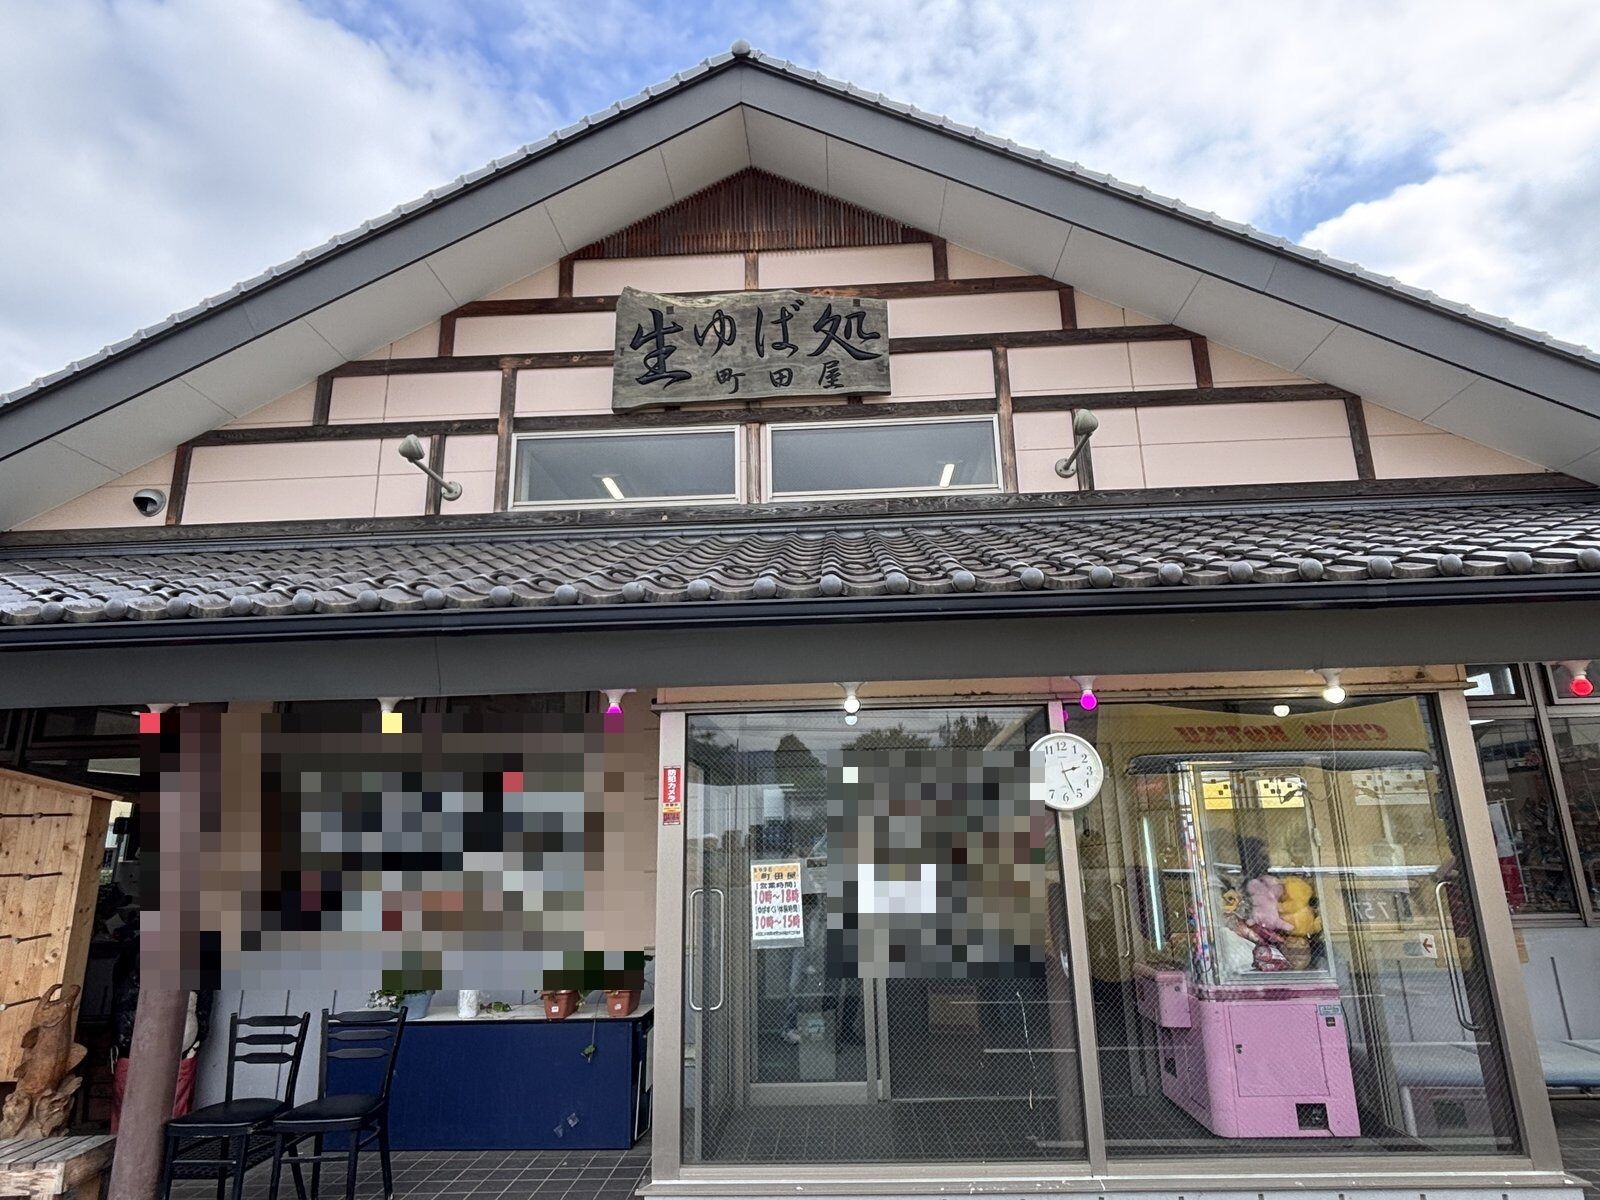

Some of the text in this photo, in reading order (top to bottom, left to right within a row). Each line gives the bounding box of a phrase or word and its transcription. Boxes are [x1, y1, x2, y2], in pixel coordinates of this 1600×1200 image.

[629, 300, 883, 391] 生ゆば処
[715, 359, 845, 395] 町田屋
[1056, 742, 1067, 751] 12
[1081, 754, 1088, 763] 2
[1086, 766, 1093, 775] 3
[667, 769, 678, 802] 防犯カメラ
[1049, 789, 1055, 799] 7
[1063, 792, 1069, 802] 6
[1076, 788, 1083, 798] 5
